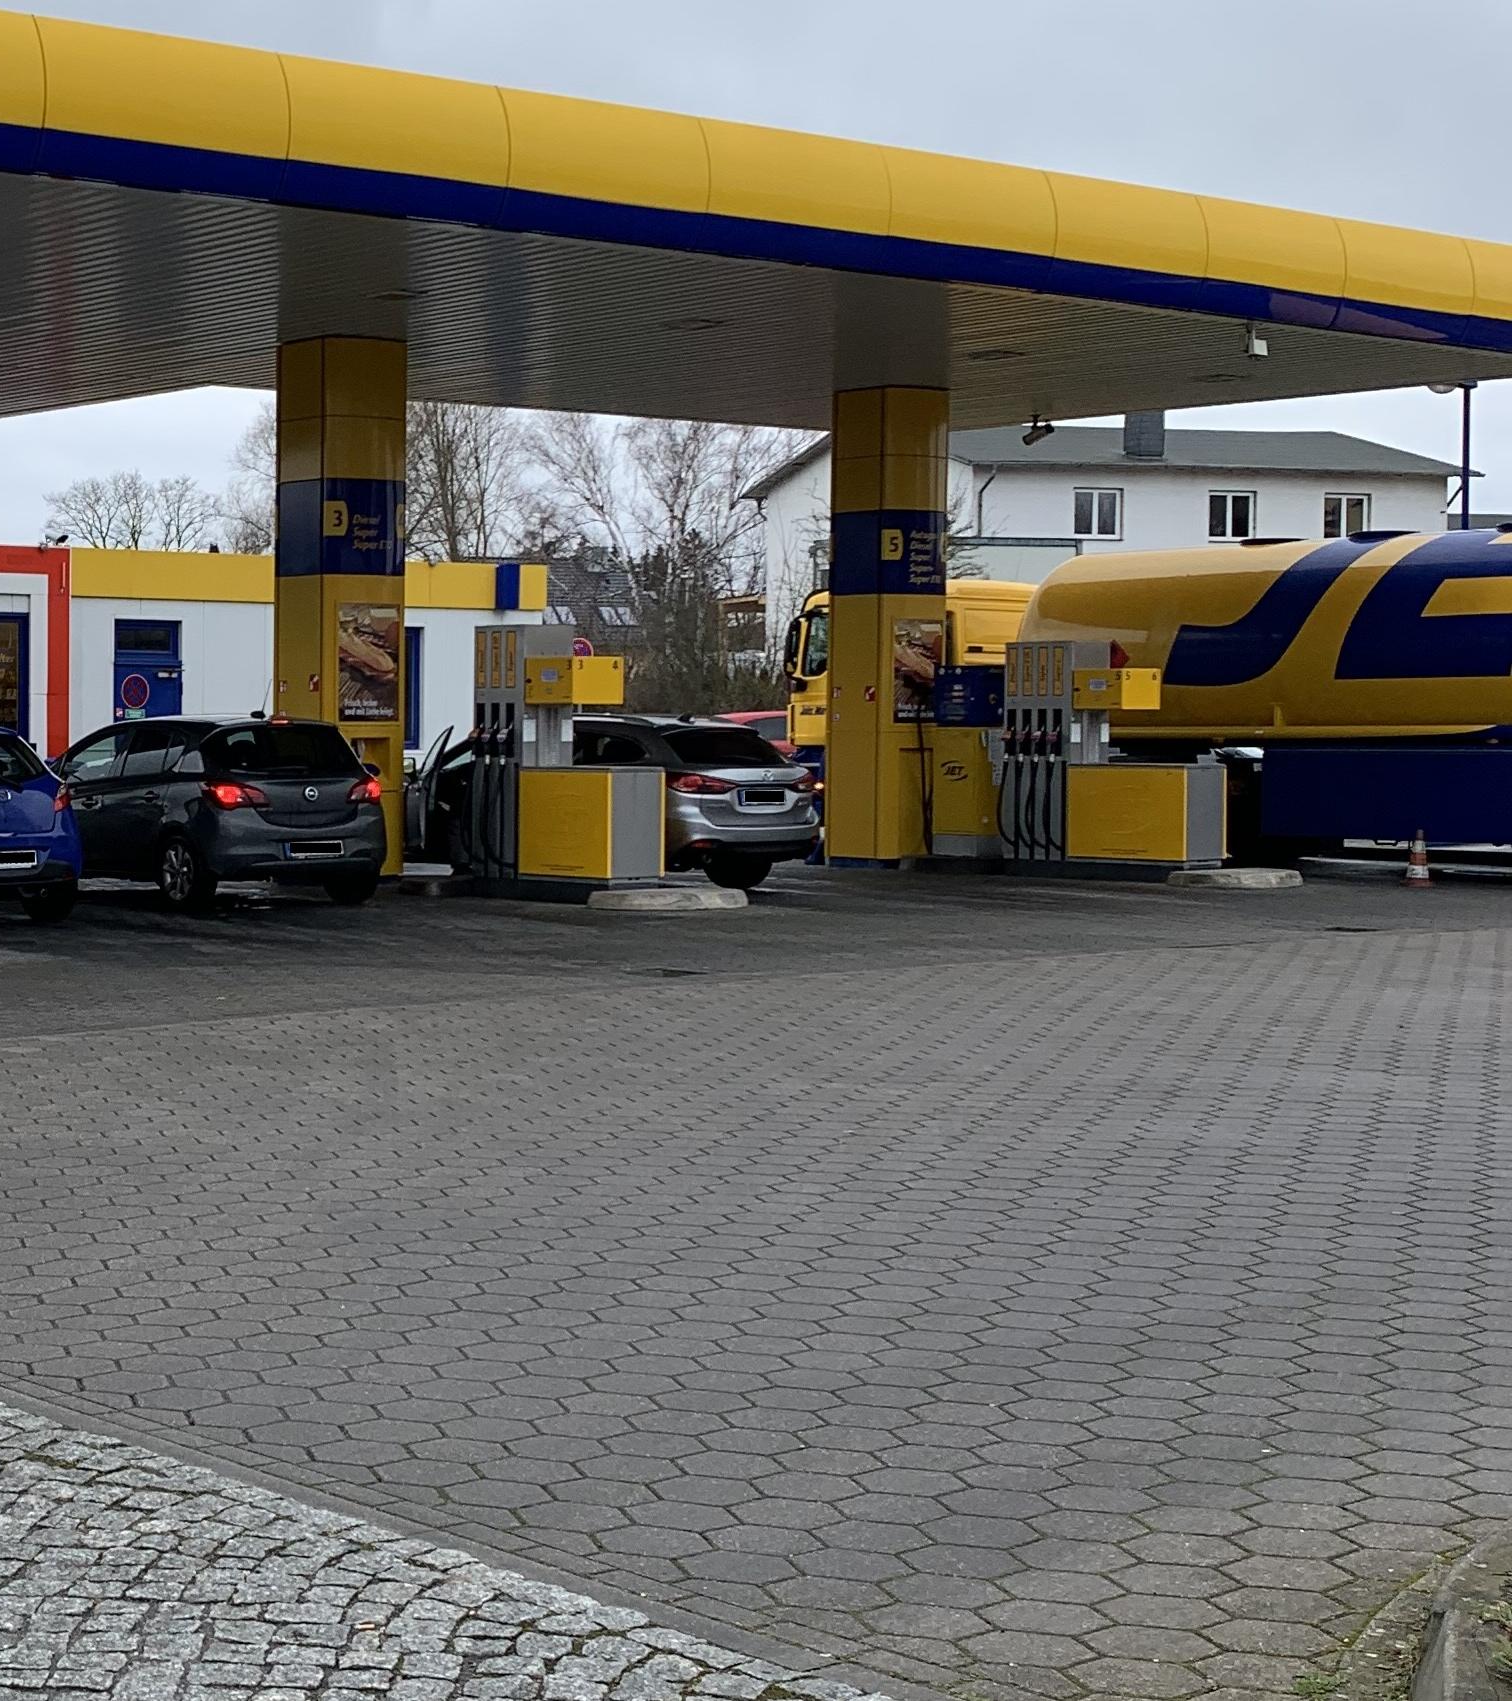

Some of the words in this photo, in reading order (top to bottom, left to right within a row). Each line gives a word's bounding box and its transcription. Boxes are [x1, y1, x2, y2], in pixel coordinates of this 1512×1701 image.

[333, 509, 343, 527] 3
[889, 536, 899, 552] 5
[943, 766, 966, 776] JET
